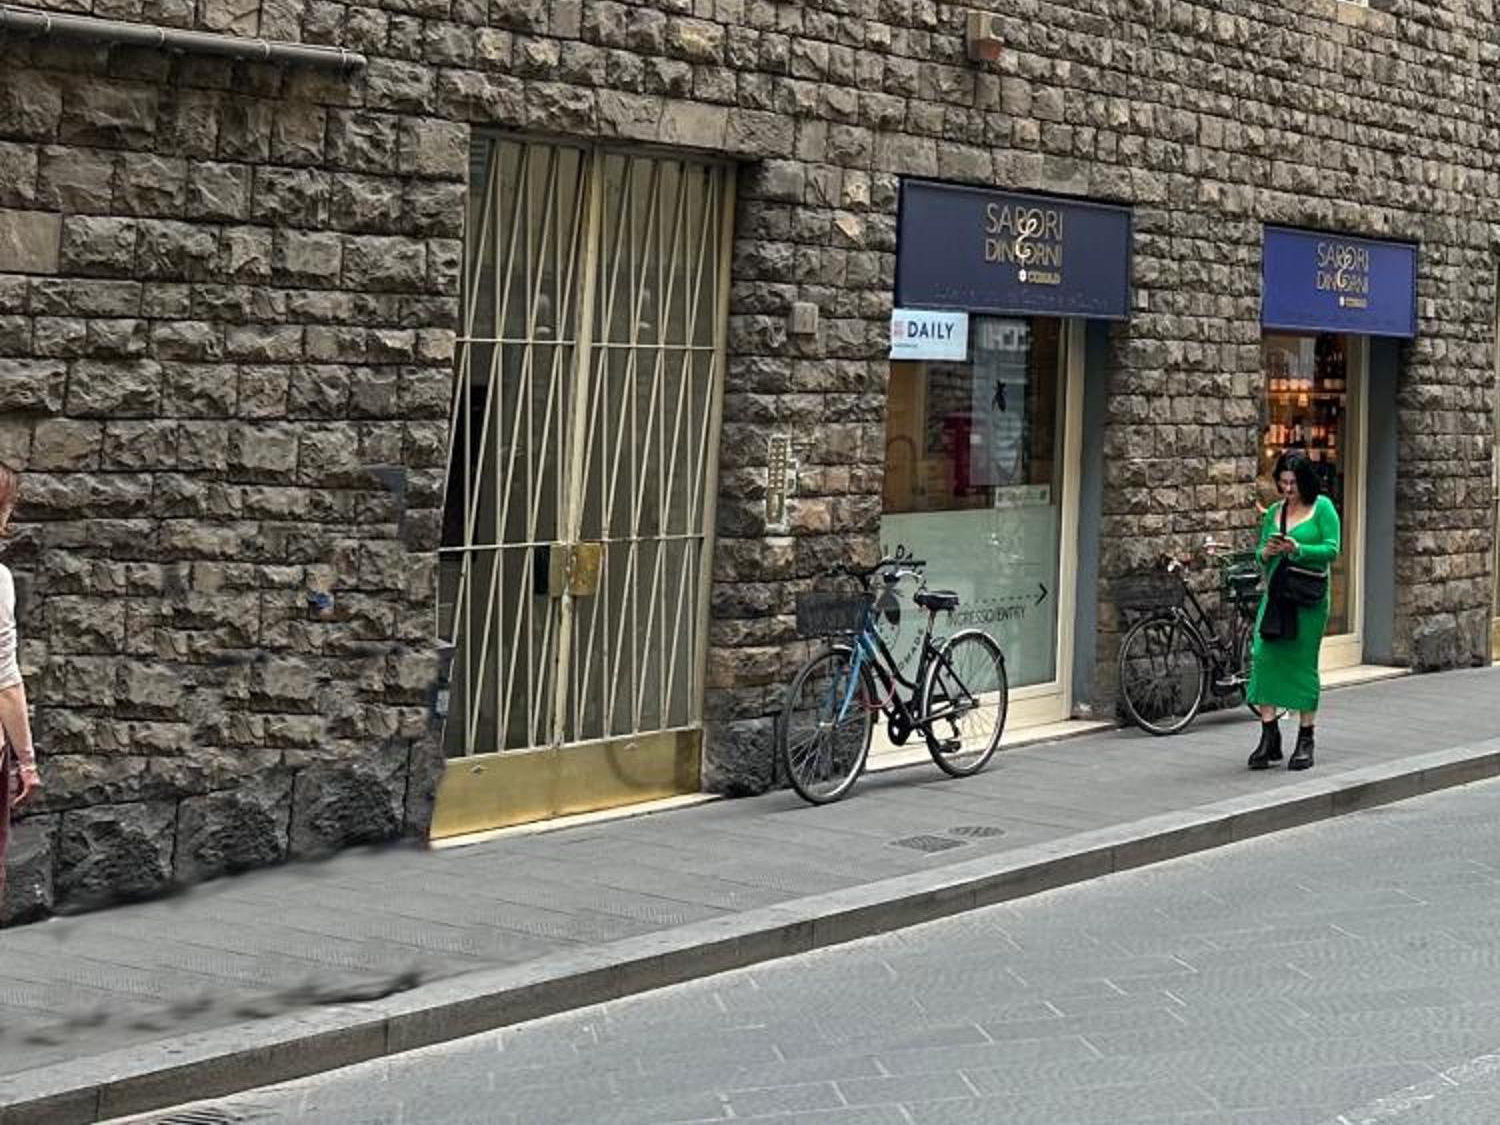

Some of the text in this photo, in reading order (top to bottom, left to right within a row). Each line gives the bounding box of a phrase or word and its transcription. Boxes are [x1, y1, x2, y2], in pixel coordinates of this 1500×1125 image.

[985, 202, 1063, 241] SAPORI
[1317, 242, 1369, 272] SAPORI
[907, 320, 954, 340] DAILY
